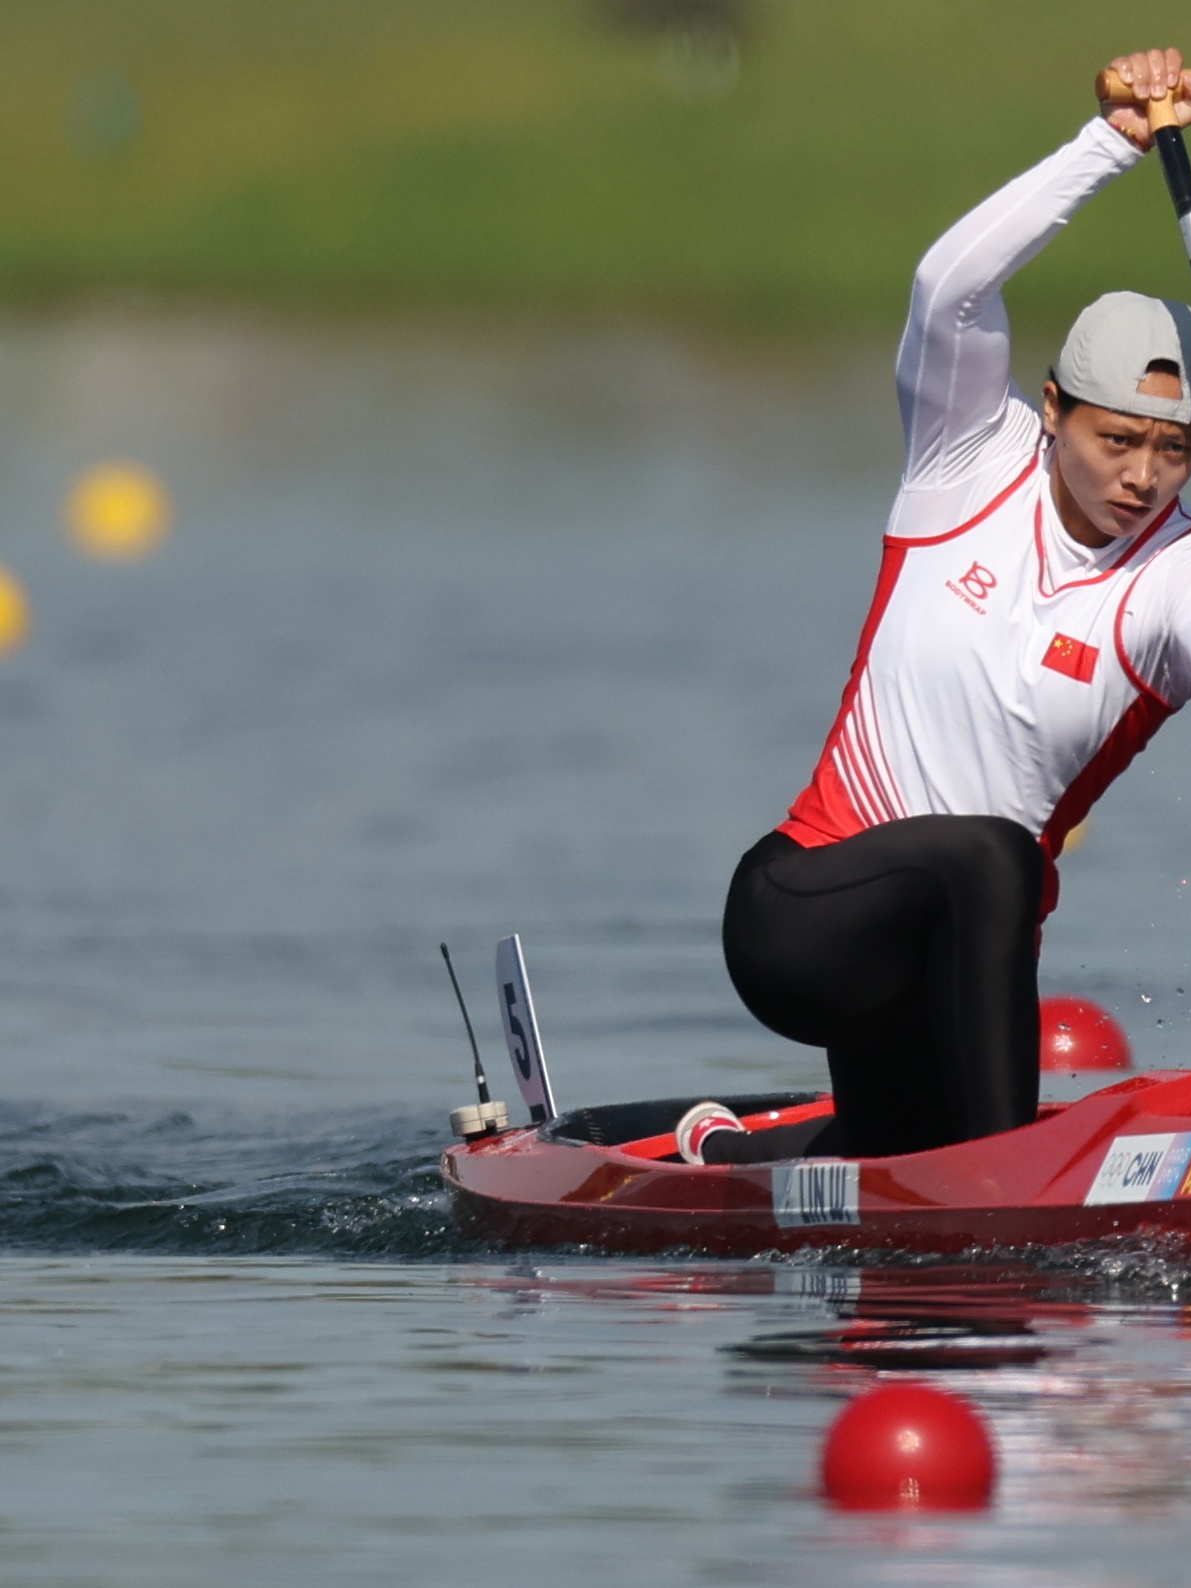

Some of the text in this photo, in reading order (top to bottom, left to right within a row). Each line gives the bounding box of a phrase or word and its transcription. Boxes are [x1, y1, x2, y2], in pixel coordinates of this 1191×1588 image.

[945, 579, 987, 616] BODYWRAP
[504, 982, 531, 1081] 5
[1122, 1150, 1164, 1188] CHN
[800, 1165, 827, 1224] LIN
